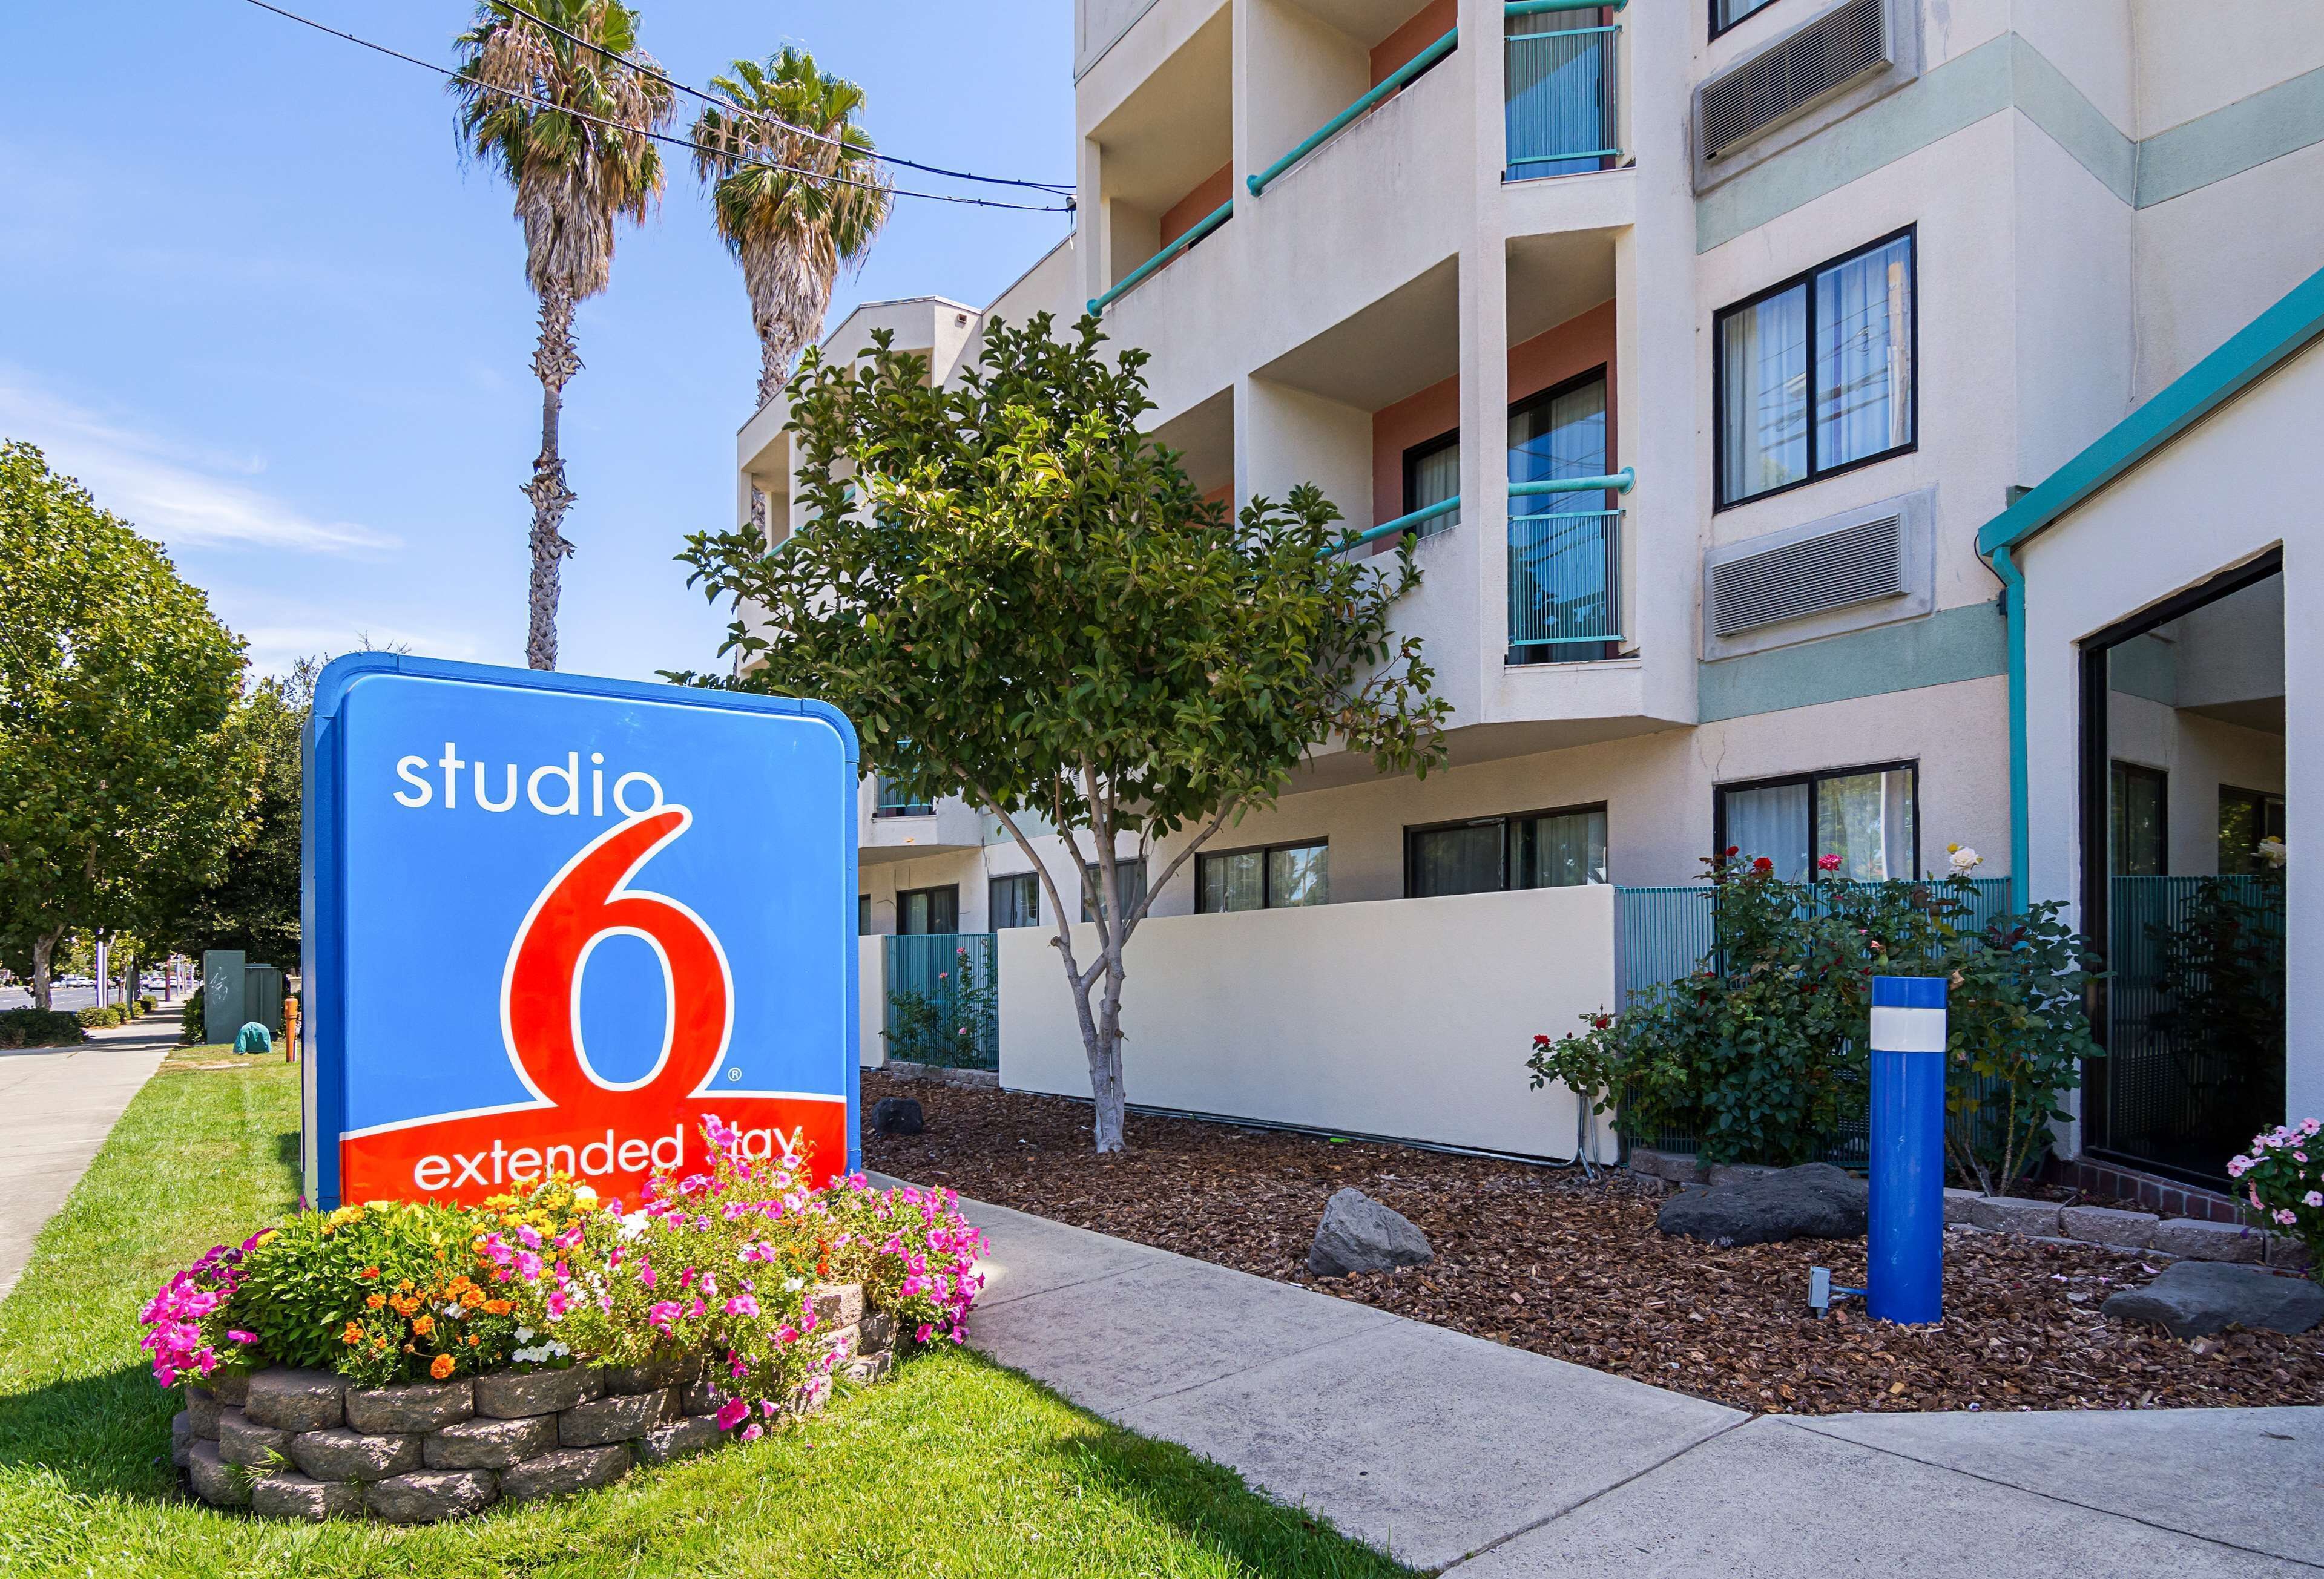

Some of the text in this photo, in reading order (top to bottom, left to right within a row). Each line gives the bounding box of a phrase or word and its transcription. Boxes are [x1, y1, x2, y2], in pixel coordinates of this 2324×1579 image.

[393, 742, 665, 818] studio
[500, 803, 735, 1108] 6
[414, 1121, 803, 1191] extended tay
